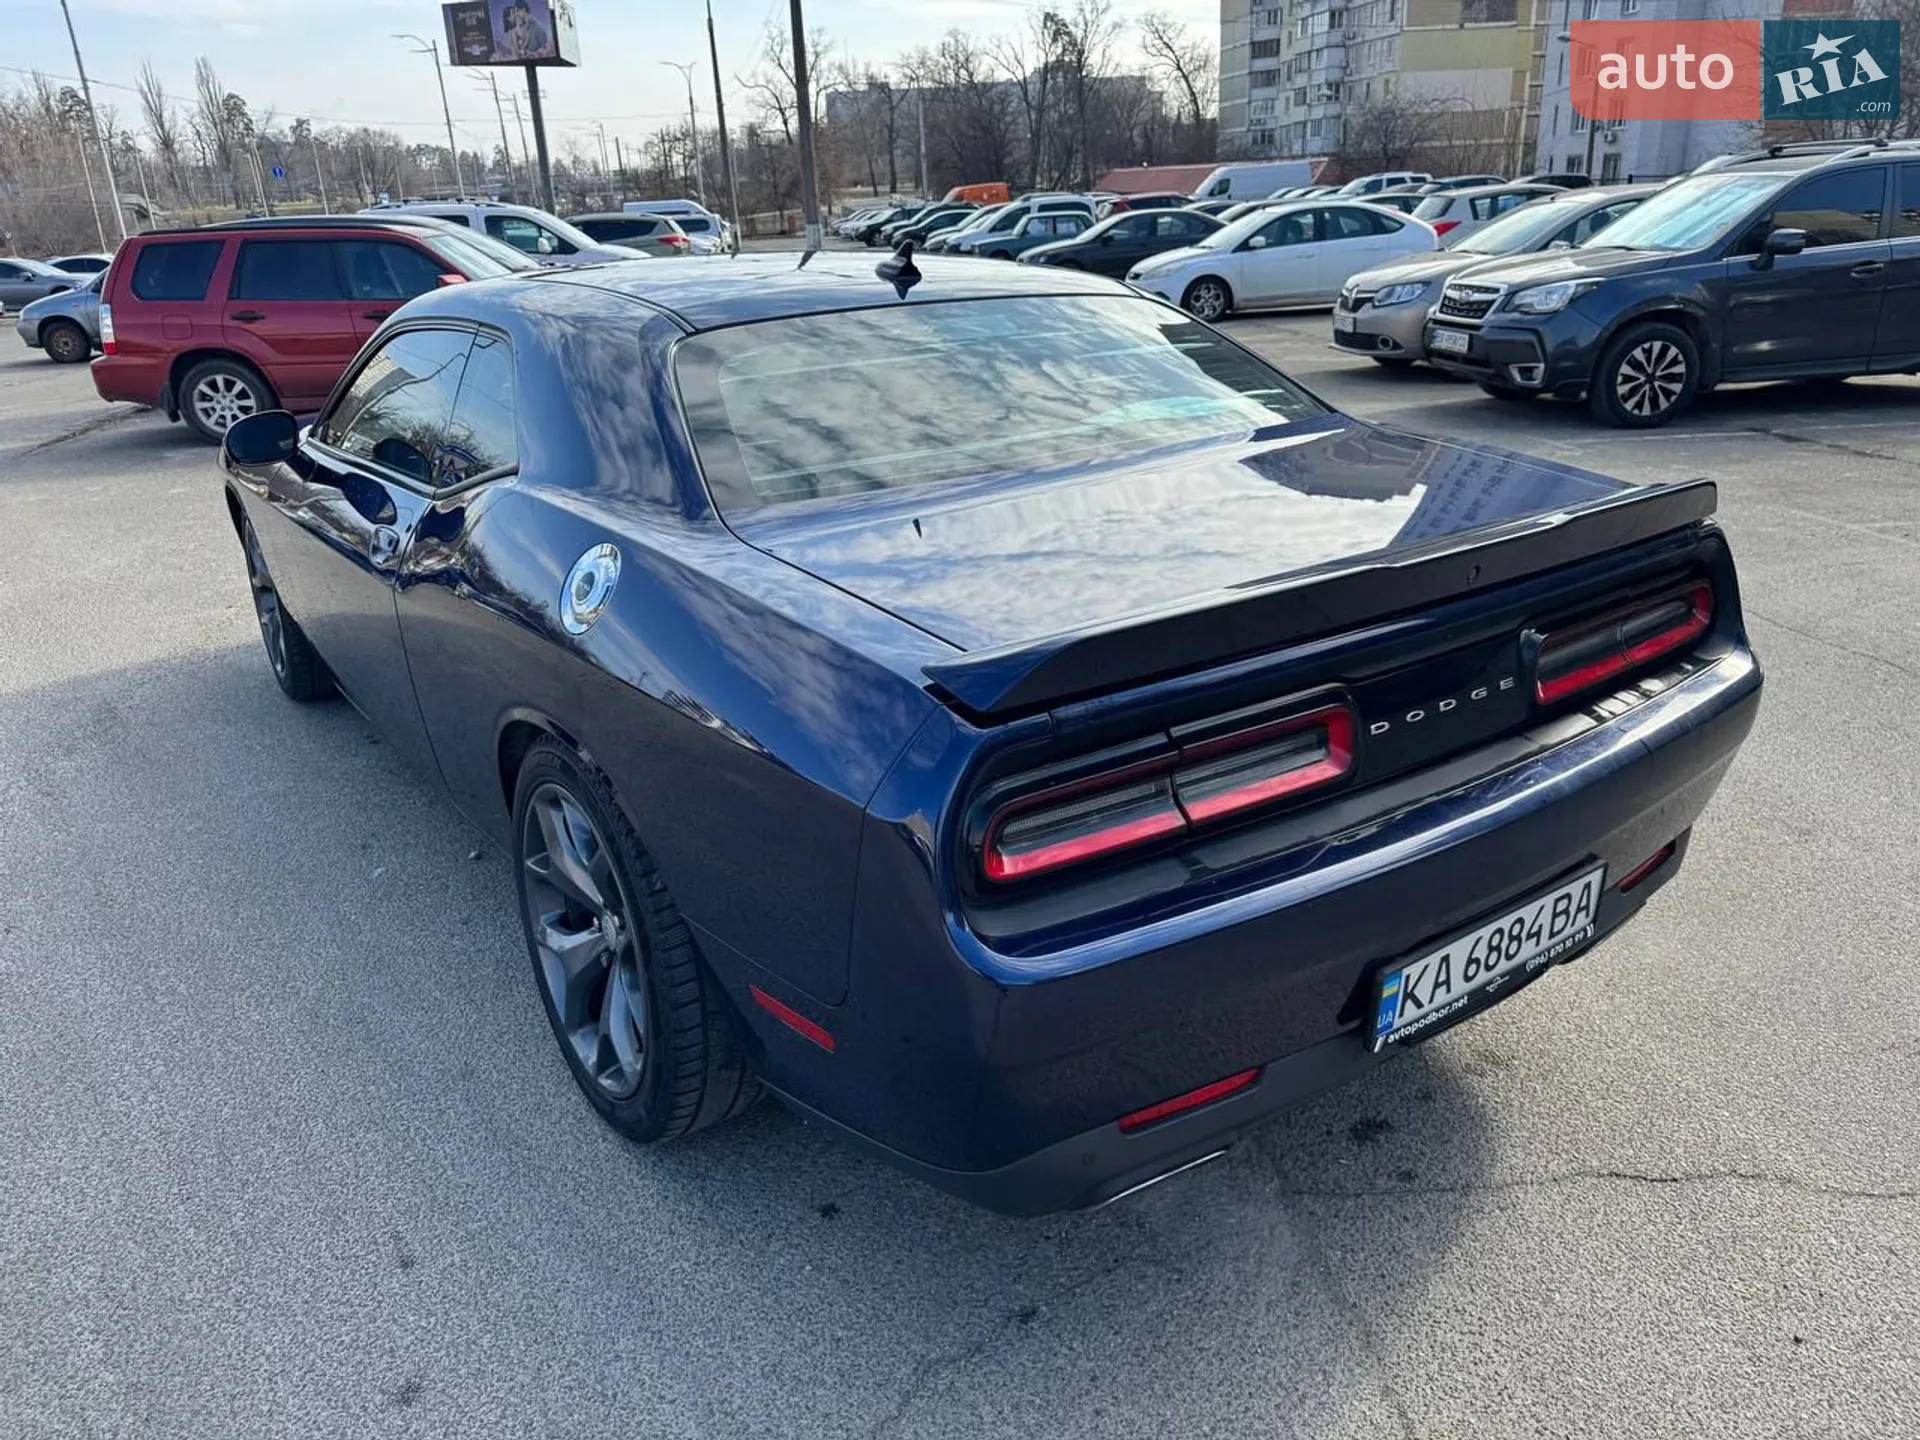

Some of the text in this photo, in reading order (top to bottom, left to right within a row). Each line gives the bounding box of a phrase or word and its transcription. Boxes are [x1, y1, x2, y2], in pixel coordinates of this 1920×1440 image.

[1370, 676, 1514, 735] DODGE
[1377, 1012, 1394, 1029] UA
[1387, 995, 1468, 1044] avtopodbor.net
